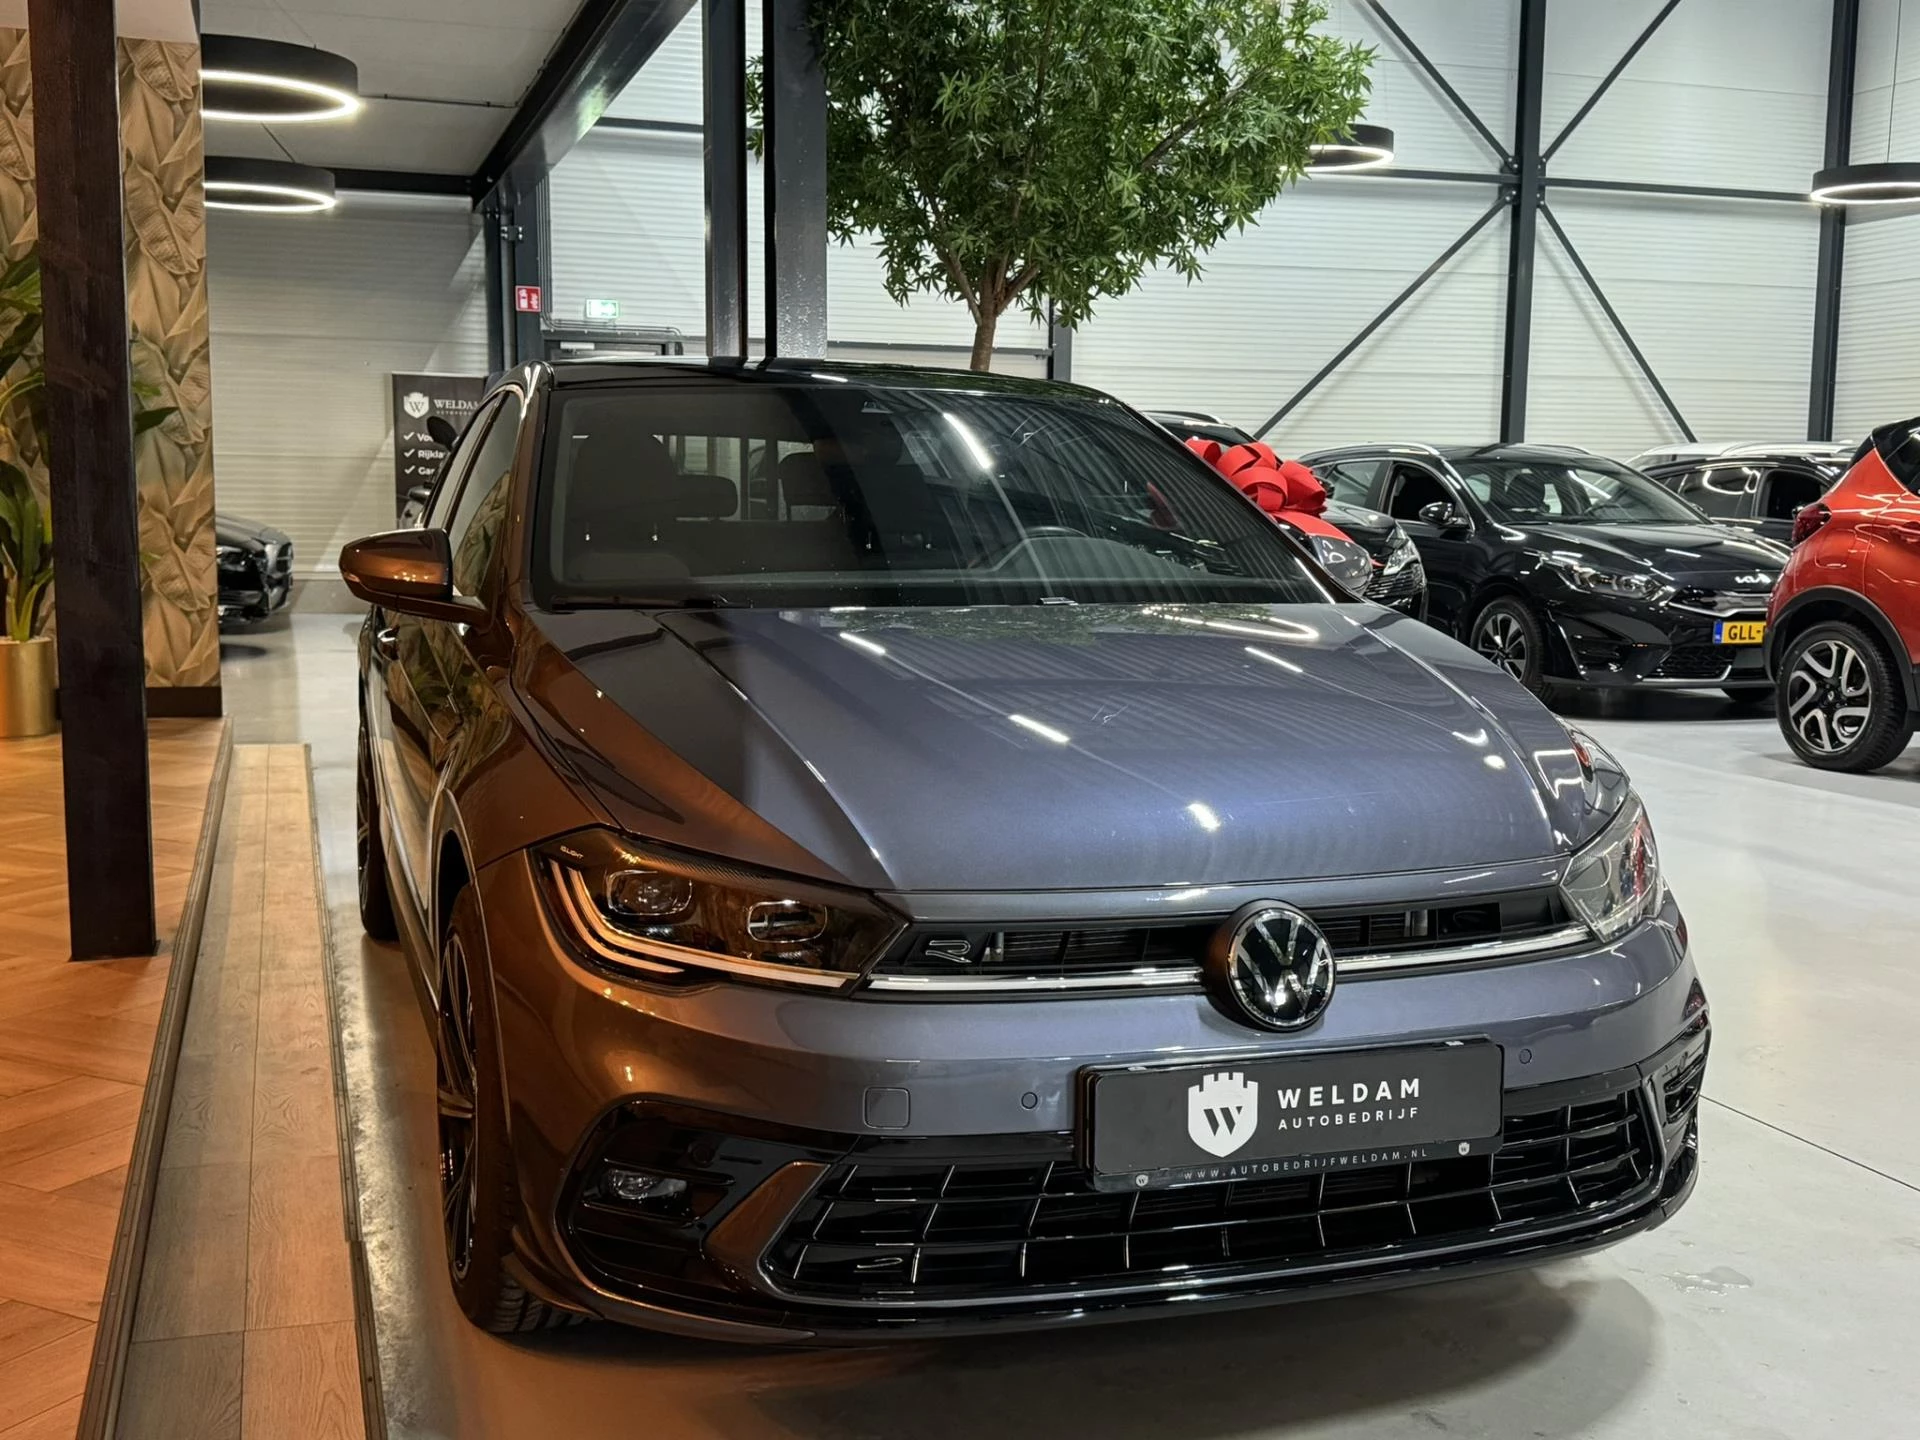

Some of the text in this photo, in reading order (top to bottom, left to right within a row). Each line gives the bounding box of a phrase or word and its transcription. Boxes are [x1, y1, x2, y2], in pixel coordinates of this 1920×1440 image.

[1728, 624, 1766, 640] GLL-
[1277, 1078, 1420, 1110] WELDAM
[1203, 1106, 1243, 1137] W
[1278, 1107, 1418, 1130] AUTOBEDRIJF
[1184, 1148, 1428, 1180] WWW.AUTOBEDRIJFWELDAM.NL
